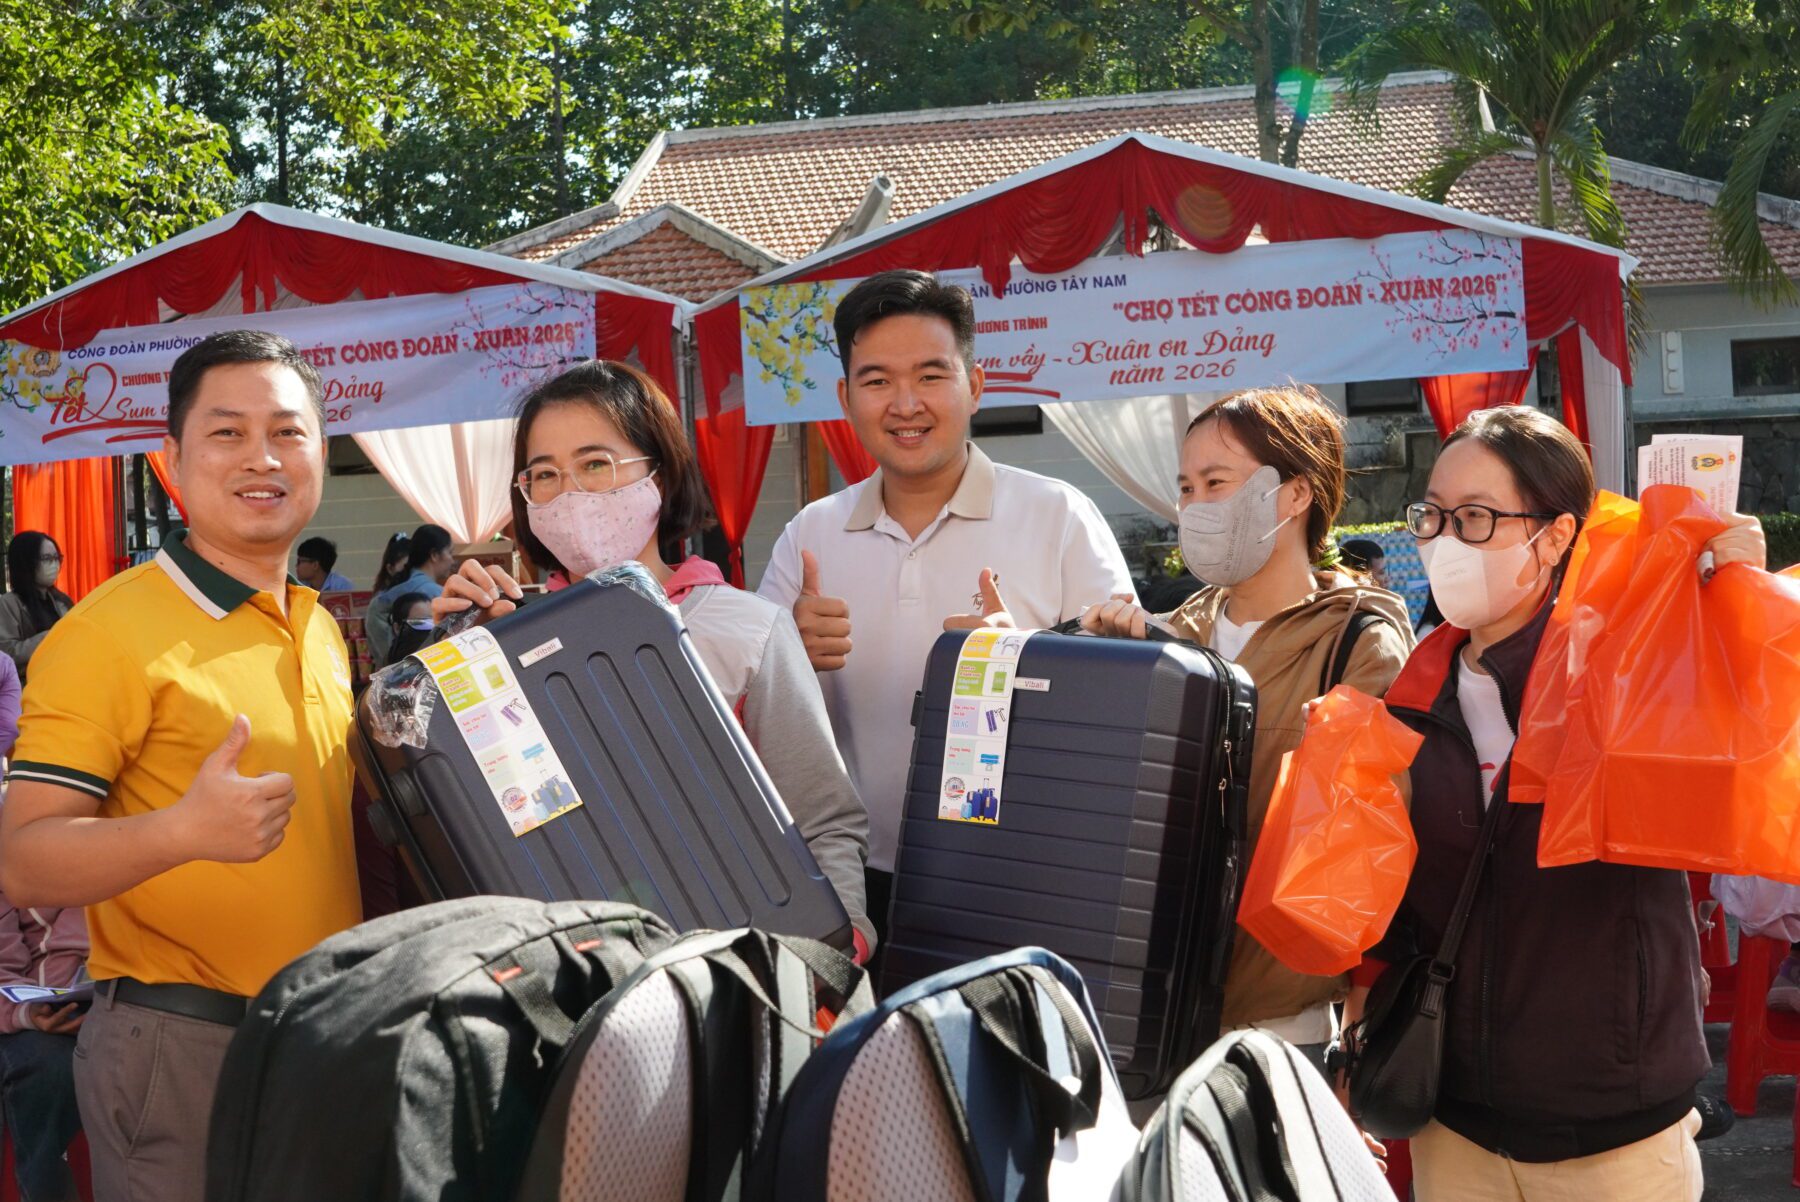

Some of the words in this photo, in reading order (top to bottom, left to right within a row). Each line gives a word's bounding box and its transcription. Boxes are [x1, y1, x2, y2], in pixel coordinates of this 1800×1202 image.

[971, 283, 989, 298] ÀN
[1002, 278, 1057, 297] HƯỜNG
[1062, 275, 1088, 291] TÂY
[1093, 274, 1127, 288] NAM
[1178, 289, 1219, 318] TẾT
[1225, 288, 1292, 314] CÔNG
[1297, 281, 1363, 309] ĐOÀN
[1380, 276, 1444, 302] XUÂN
[975, 320, 1010, 334] ƯƠNG
[1013, 316, 1048, 331] TRÌNH
[68, 345, 106, 360] CÔNG
[109, 340, 146, 356] ĐOÀN
[150, 336, 202, 351] PHƯỜNG
[340, 340, 399, 364] CÔNG
[402, 332, 459, 358] ĐOÀN
[474, 325, 529, 352] XUÂN
[974, 355, 1004, 369] um
[1009, 344, 1046, 375] vầy
[1067, 338, 1151, 366] Xuân
[1159, 339, 1188, 357] ơn
[1195, 326, 1277, 357] Đảng
[122, 371, 162, 387] CHƯƠNG
[1110, 364, 1165, 385] năm
[1174, 358, 1237, 380] 2026
[323, 375, 386, 403] Đảng
[116, 396, 156, 420] Sum
[327, 404, 352, 422] 26
